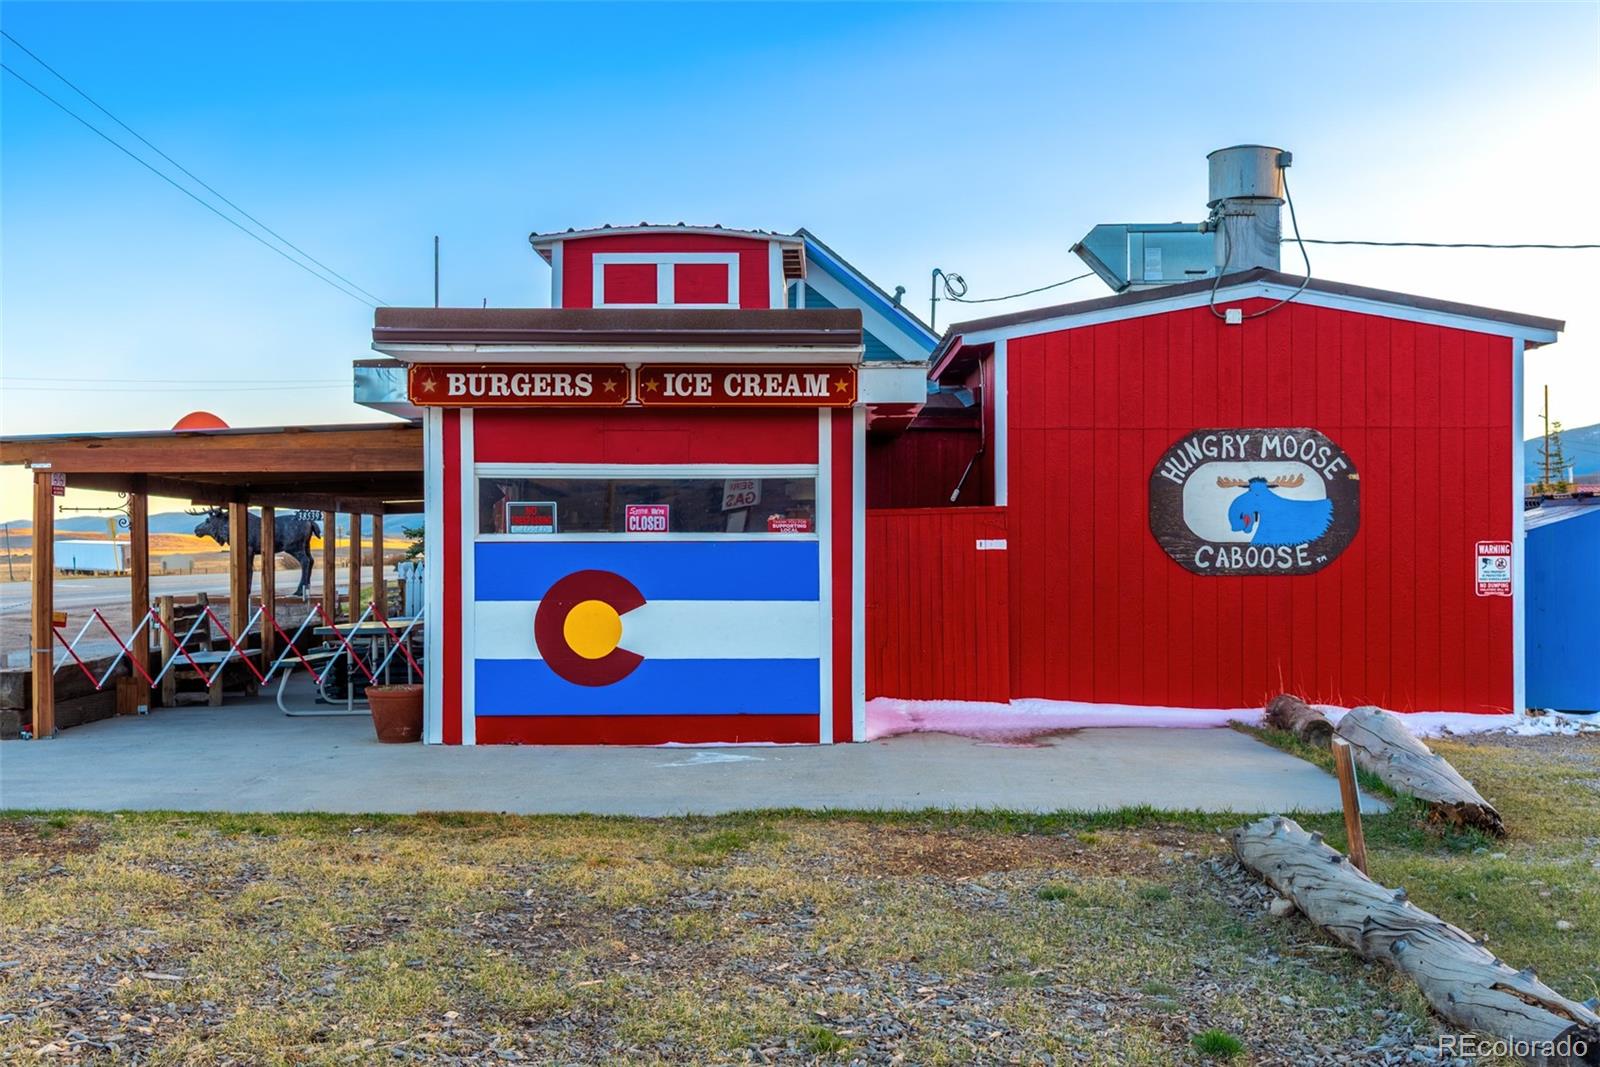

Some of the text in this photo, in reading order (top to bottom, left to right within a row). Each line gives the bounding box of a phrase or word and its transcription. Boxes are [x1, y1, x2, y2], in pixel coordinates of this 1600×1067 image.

[446, 373, 593, 397] BURGERS
[663, 373, 831, 397] ICE CREAM
[1160, 434, 1348, 484] HUNGRY MOOSE
[629, 515, 666, 531] CLOSED
[1194, 543, 1312, 569] CABOOSE
[1478, 544, 1511, 555] WARNING
